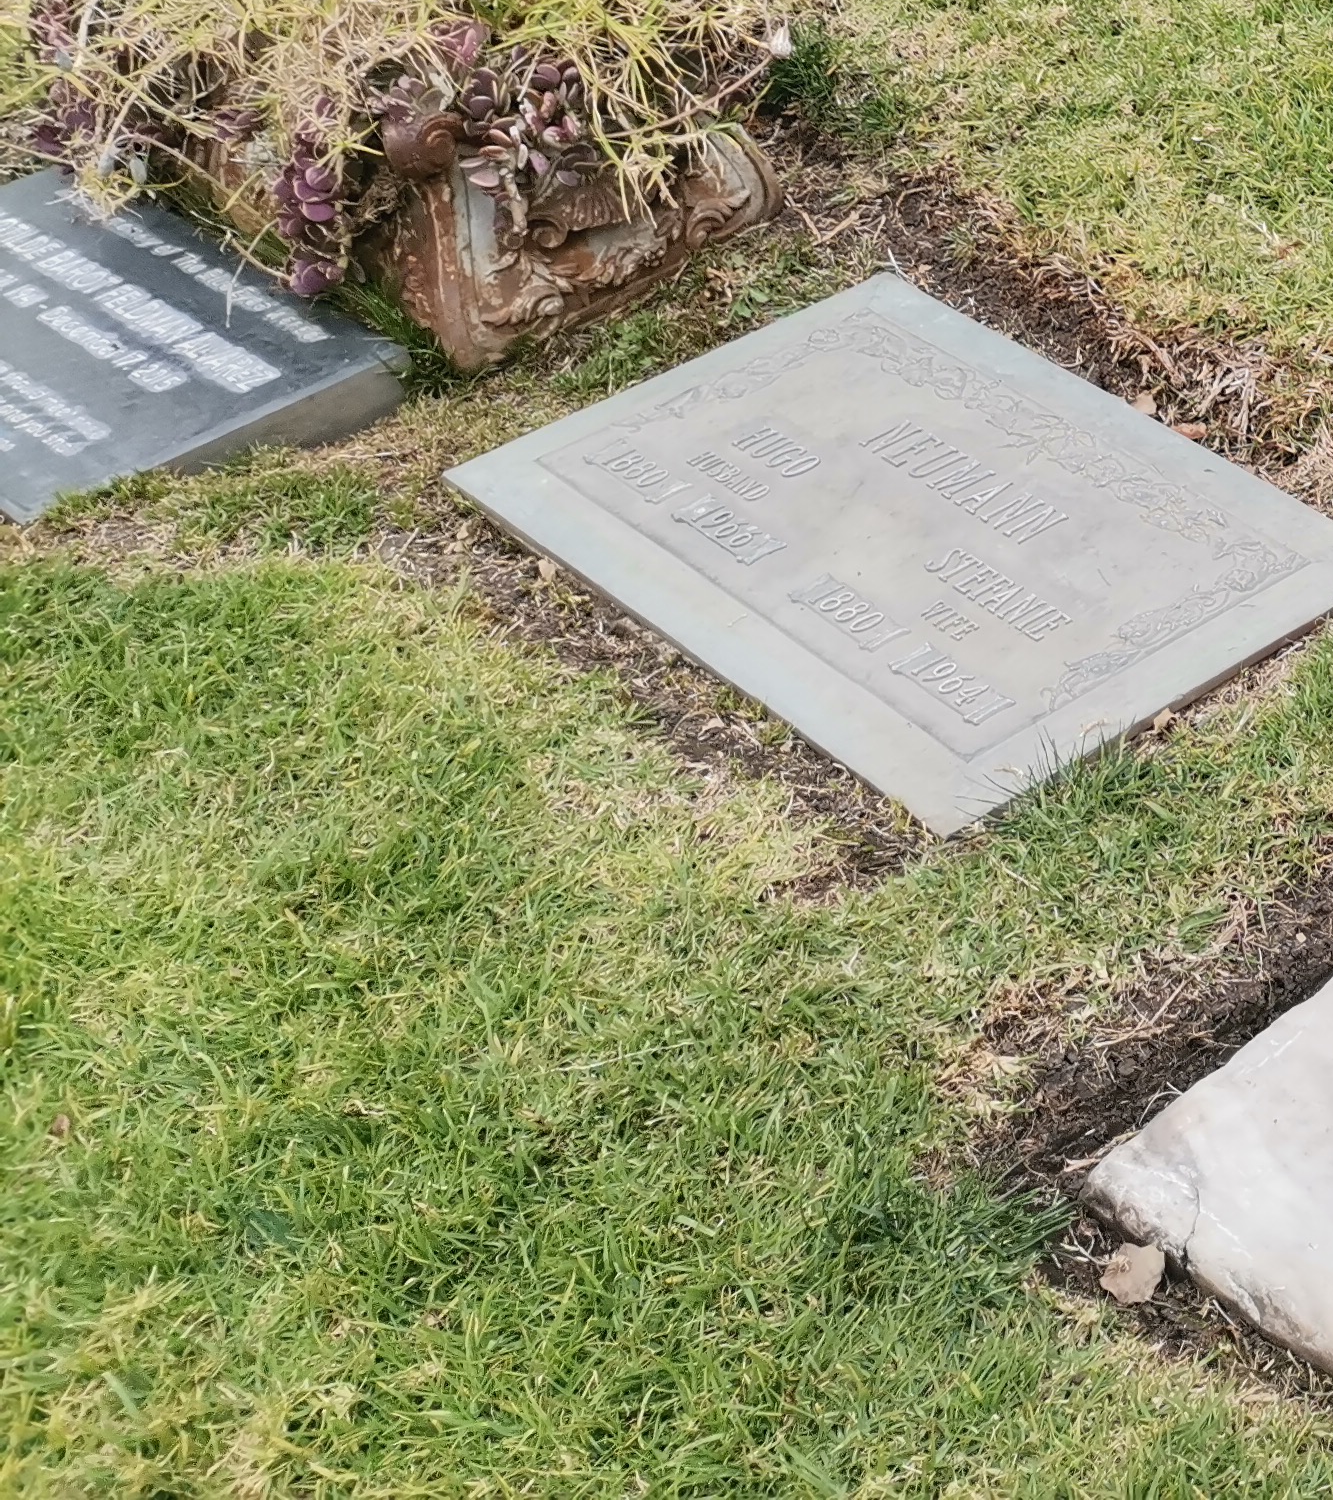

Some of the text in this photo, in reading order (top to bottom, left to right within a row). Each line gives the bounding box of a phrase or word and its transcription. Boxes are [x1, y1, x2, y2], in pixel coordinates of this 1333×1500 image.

[603, 448, 671, 491] 1880
[685, 449, 773, 503] HUSBAND
[731, 424, 823, 479] HUGO
[858, 418, 1070, 545] NEUMANN
[696, 504, 759, 550] 1966
[812, 586, 885, 635] 1880
[917, 599, 981, 642] WIFE
[923, 546, 1072, 643] STEFANIE
[910, 655, 990, 708] 1964
